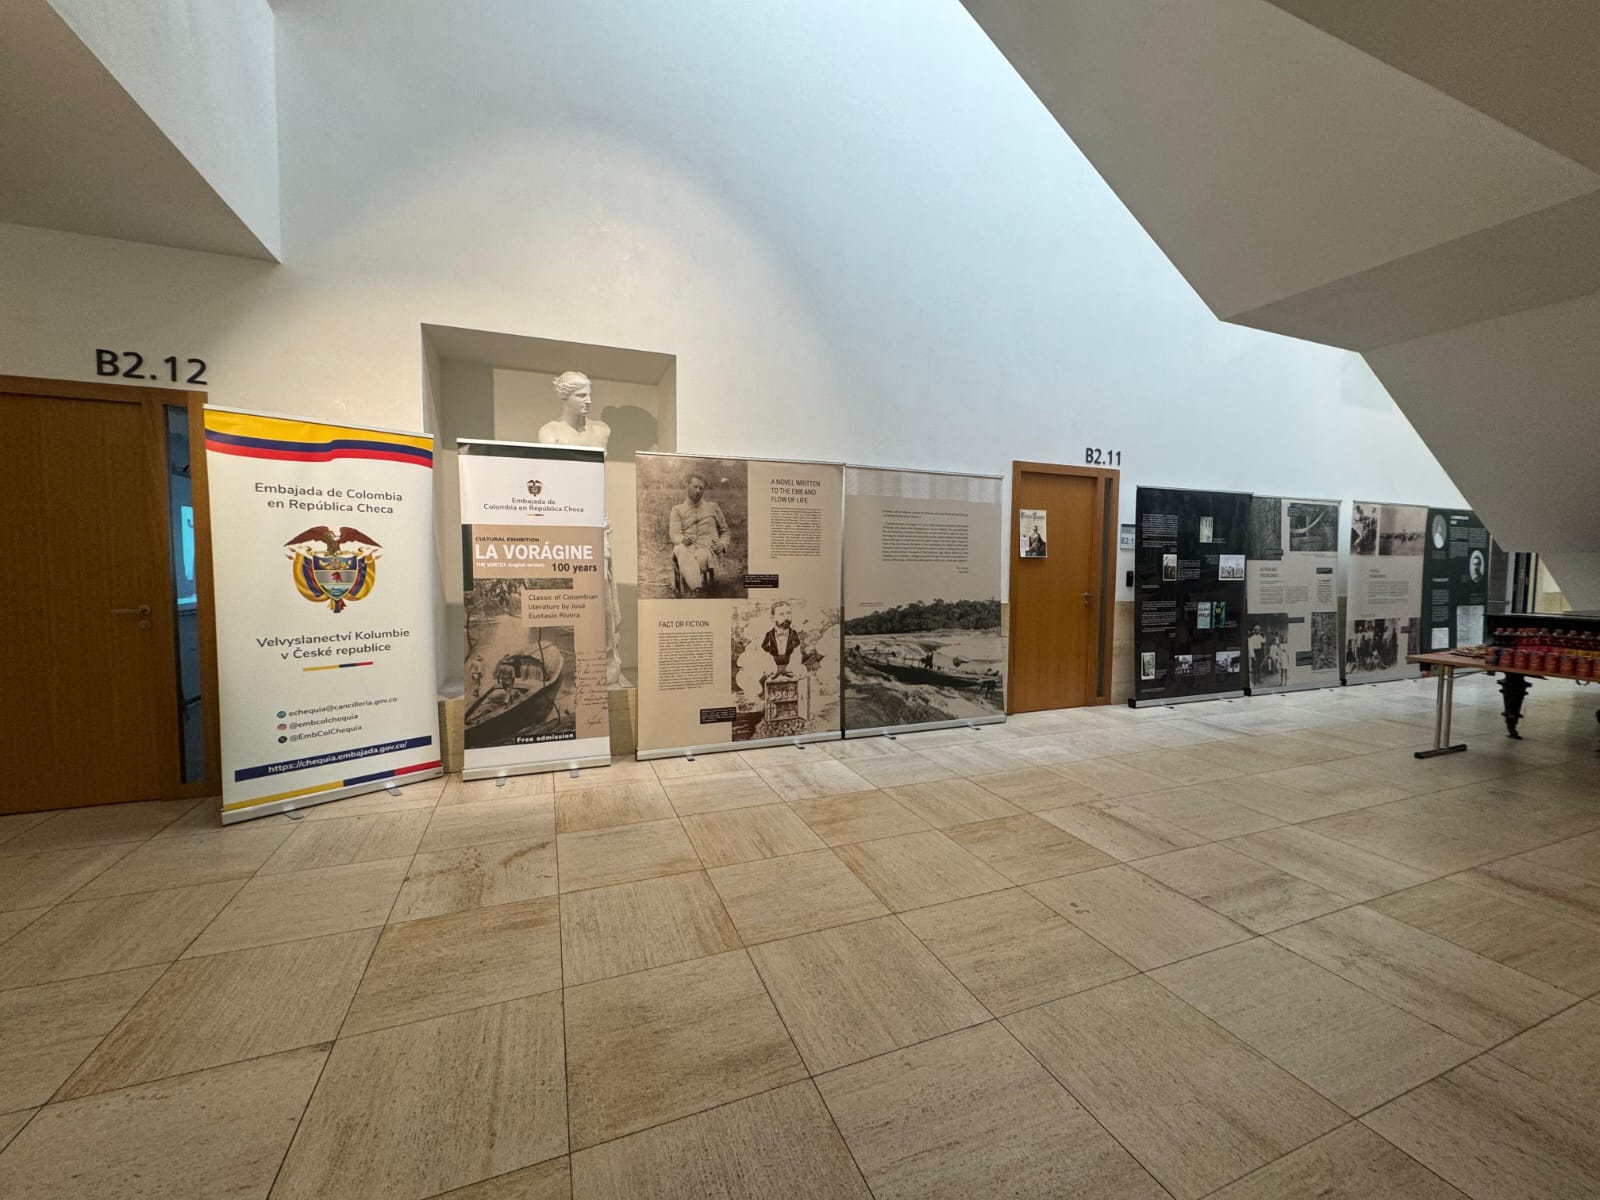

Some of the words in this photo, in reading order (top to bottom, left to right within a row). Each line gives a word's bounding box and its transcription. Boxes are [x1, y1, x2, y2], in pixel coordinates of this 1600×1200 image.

[96, 348, 208, 385] B2.12
[1085, 447, 1121, 466] B2.11
[255, 482, 323, 497] Embajada
[326, 487, 343, 498] de
[346, 489, 403, 502] Colombia
[267, 500, 285, 509] en
[289, 499, 353, 514] República
[357, 503, 394, 514] Checa
[483, 503, 517, 511] Colombia
[529, 504, 563, 513] República
[512, 497, 546, 506] Embajada
[475, 543, 498, 560] LA
[503, 541, 593, 560] VORÁGINE
[552, 563, 570, 572] 100
[572, 564, 598, 574] years
[559, 611, 581, 619] Rivera
[561, 603, 569, 611] by
[256, 632, 352, 649] Velvyslanectví
[355, 628, 410, 641] Kolumbie
[280, 652, 289, 660] v
[293, 645, 333, 659] České
[336, 643, 391, 657] republice
[289, 713, 359, 730] @embcolchequia
[289, 725, 363, 743] @EmbColChequia
[536, 732, 574, 742] admission
[267, 741, 408, 773] https://chequia.embajada.gov.co/
